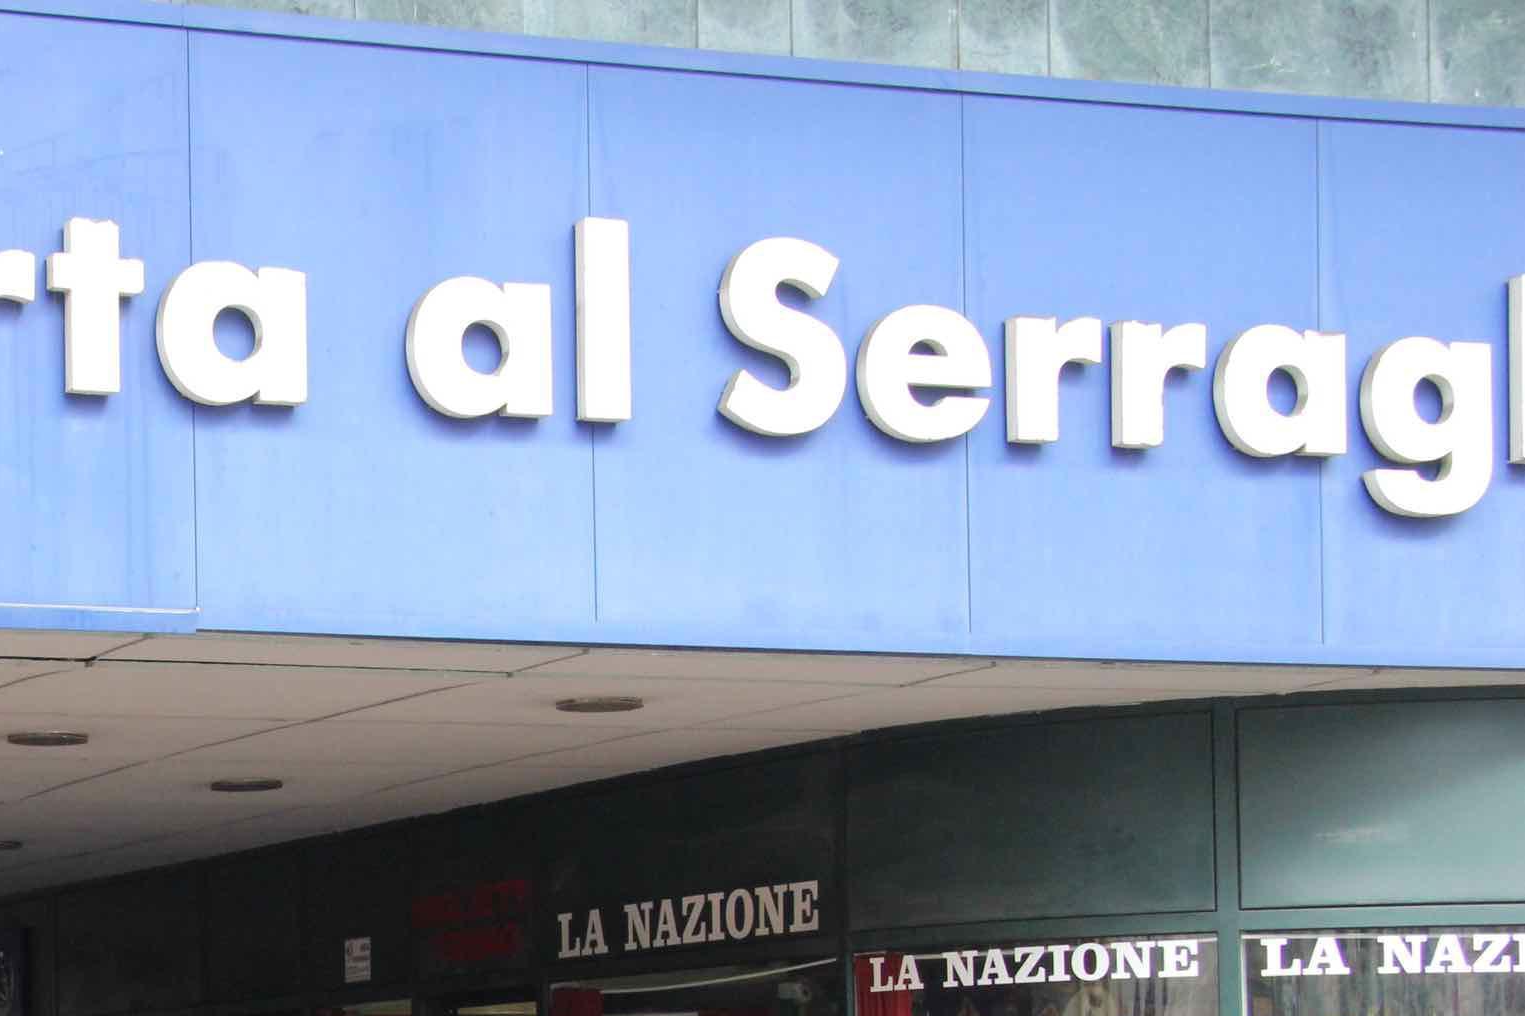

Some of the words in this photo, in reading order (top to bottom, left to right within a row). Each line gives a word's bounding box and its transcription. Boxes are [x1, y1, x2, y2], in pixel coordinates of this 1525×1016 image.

[406, 216, 632, 424] al
[557, 908, 609, 959] LA
[624, 880, 819, 951] NAZIONE
[869, 955, 924, 993] LA
[941, 940, 1199, 989] NAZIONE
[1260, 936, 1351, 977] LA
